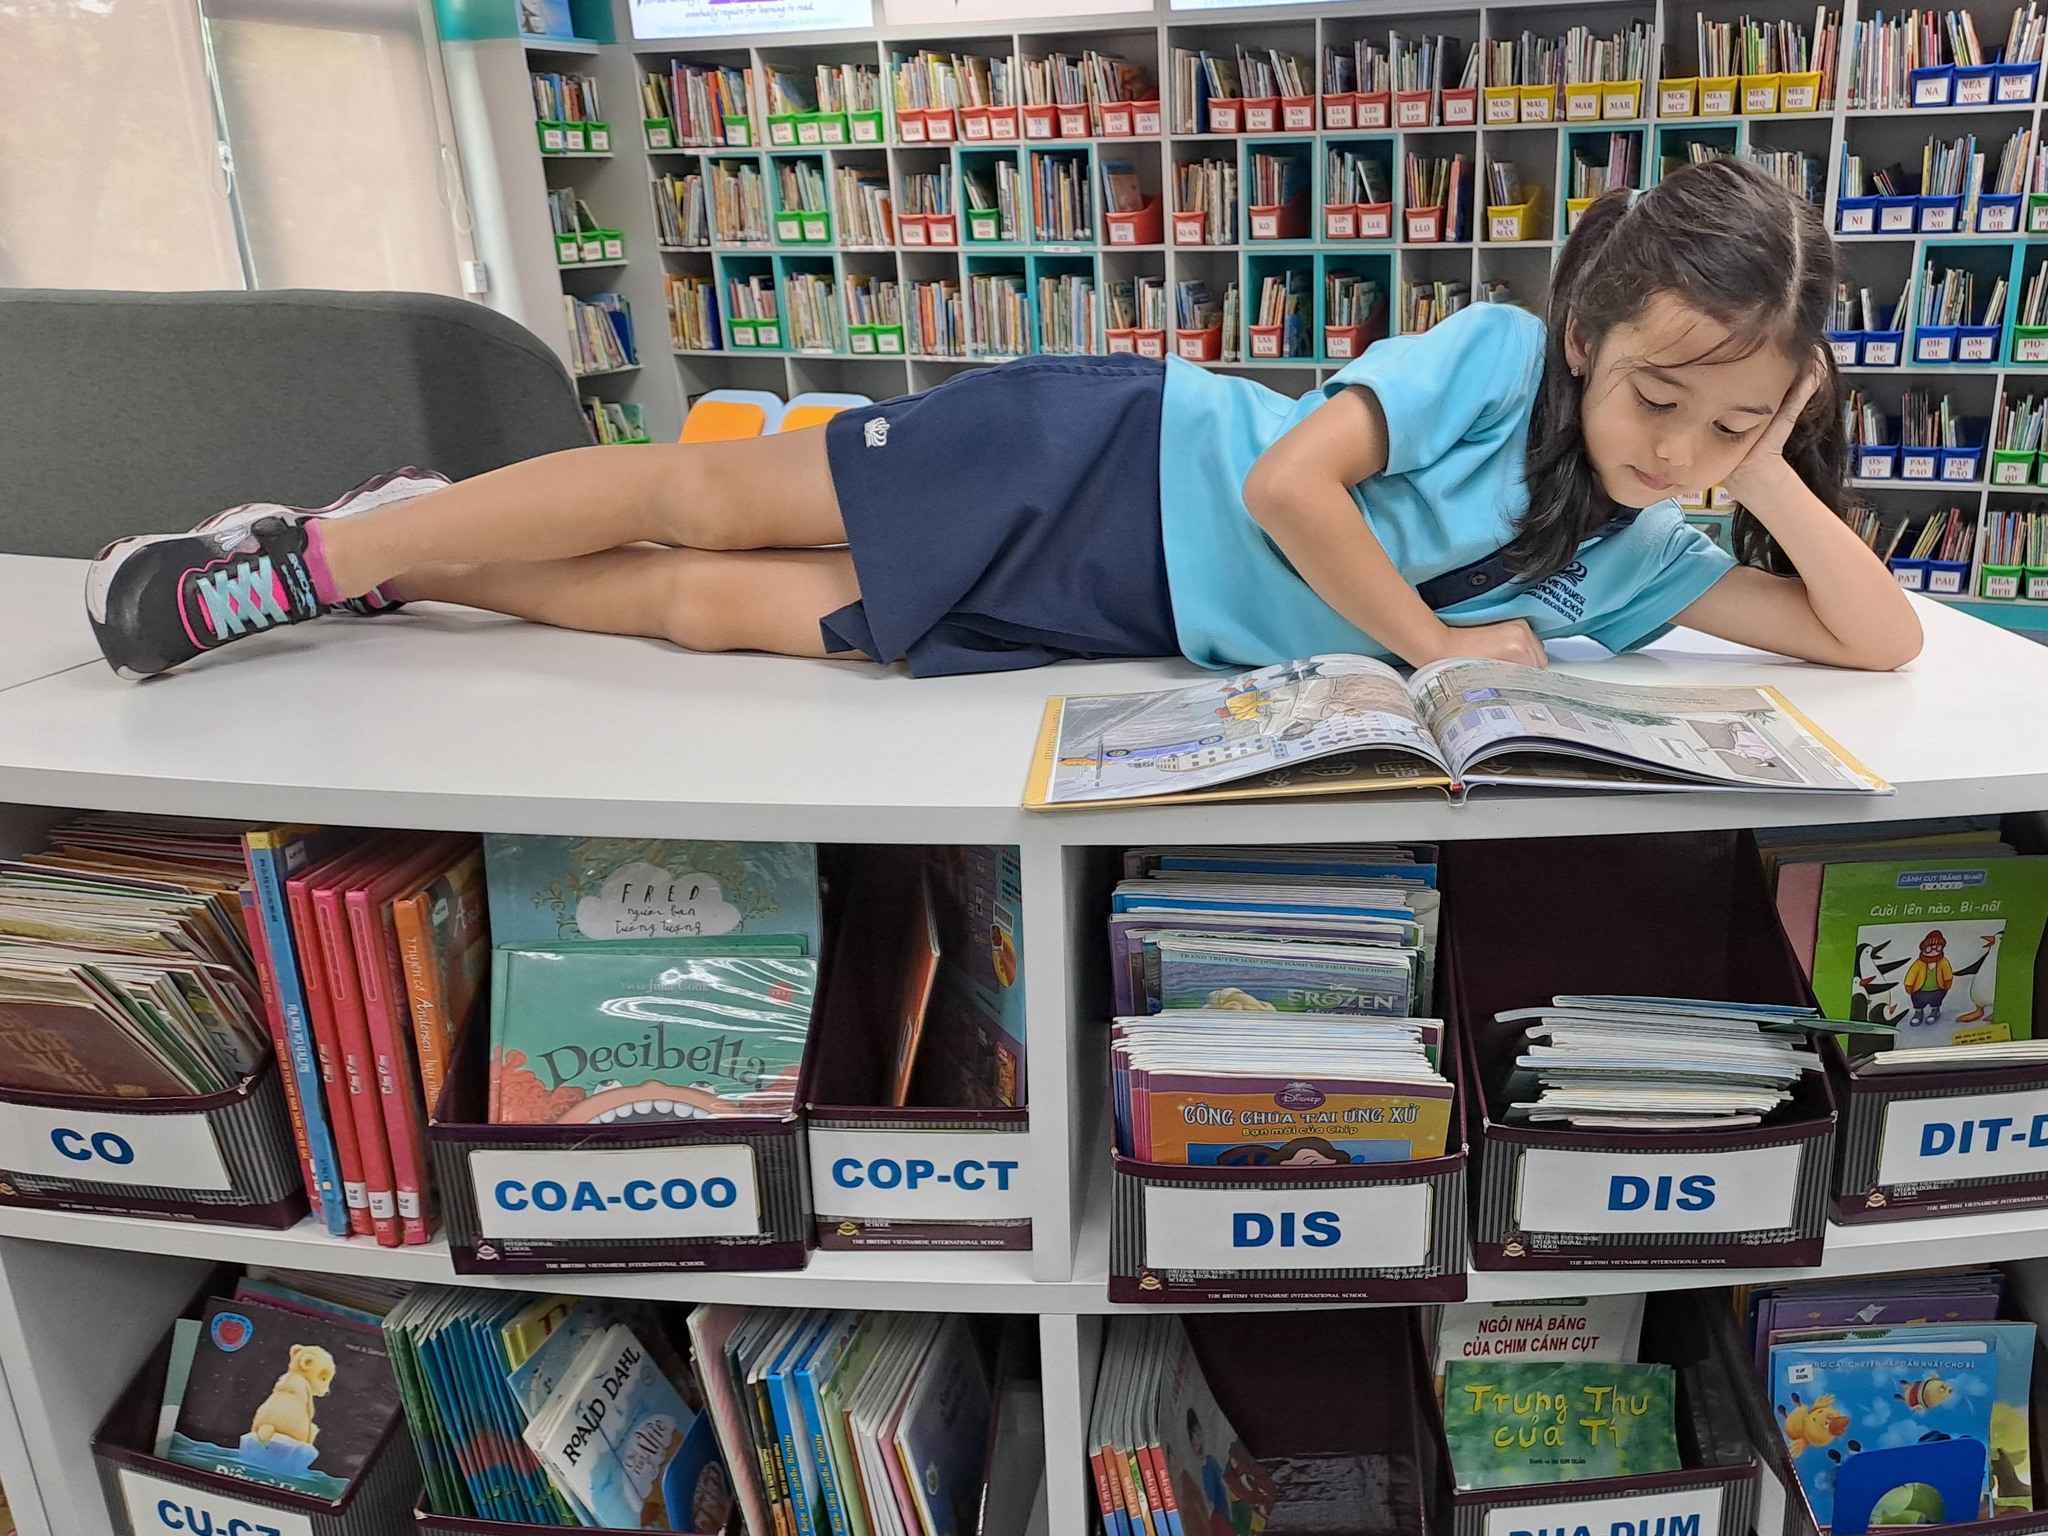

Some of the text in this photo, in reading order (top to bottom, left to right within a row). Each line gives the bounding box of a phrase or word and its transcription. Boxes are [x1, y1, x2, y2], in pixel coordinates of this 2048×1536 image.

[621, 883, 700, 904] FRED
[1288, 989, 1395, 1011] FROZEN
[538, 1021, 768, 1092] Decibella
[1184, 1103, 1234, 1126] CÔNG
[1281, 1092, 1322, 1105] Disney
[50, 1126, 136, 1168] CO
[831, 1157, 1020, 1193] COP-CT
[494, 1176, 738, 1213] COA-COO
[1607, 1174, 1718, 1213] DIS
[1231, 1210, 1343, 1249] DIS
[1478, 1315, 1513, 1335] NGÔI
[1515, 1314, 1545, 1333] NHÀ
[1463, 1332, 1601, 1358] CỦA CHIM CÁNH CỤT
[561, 1346, 642, 1469] ROALD DAHL
[1464, 1383, 1568, 1426] Trung
